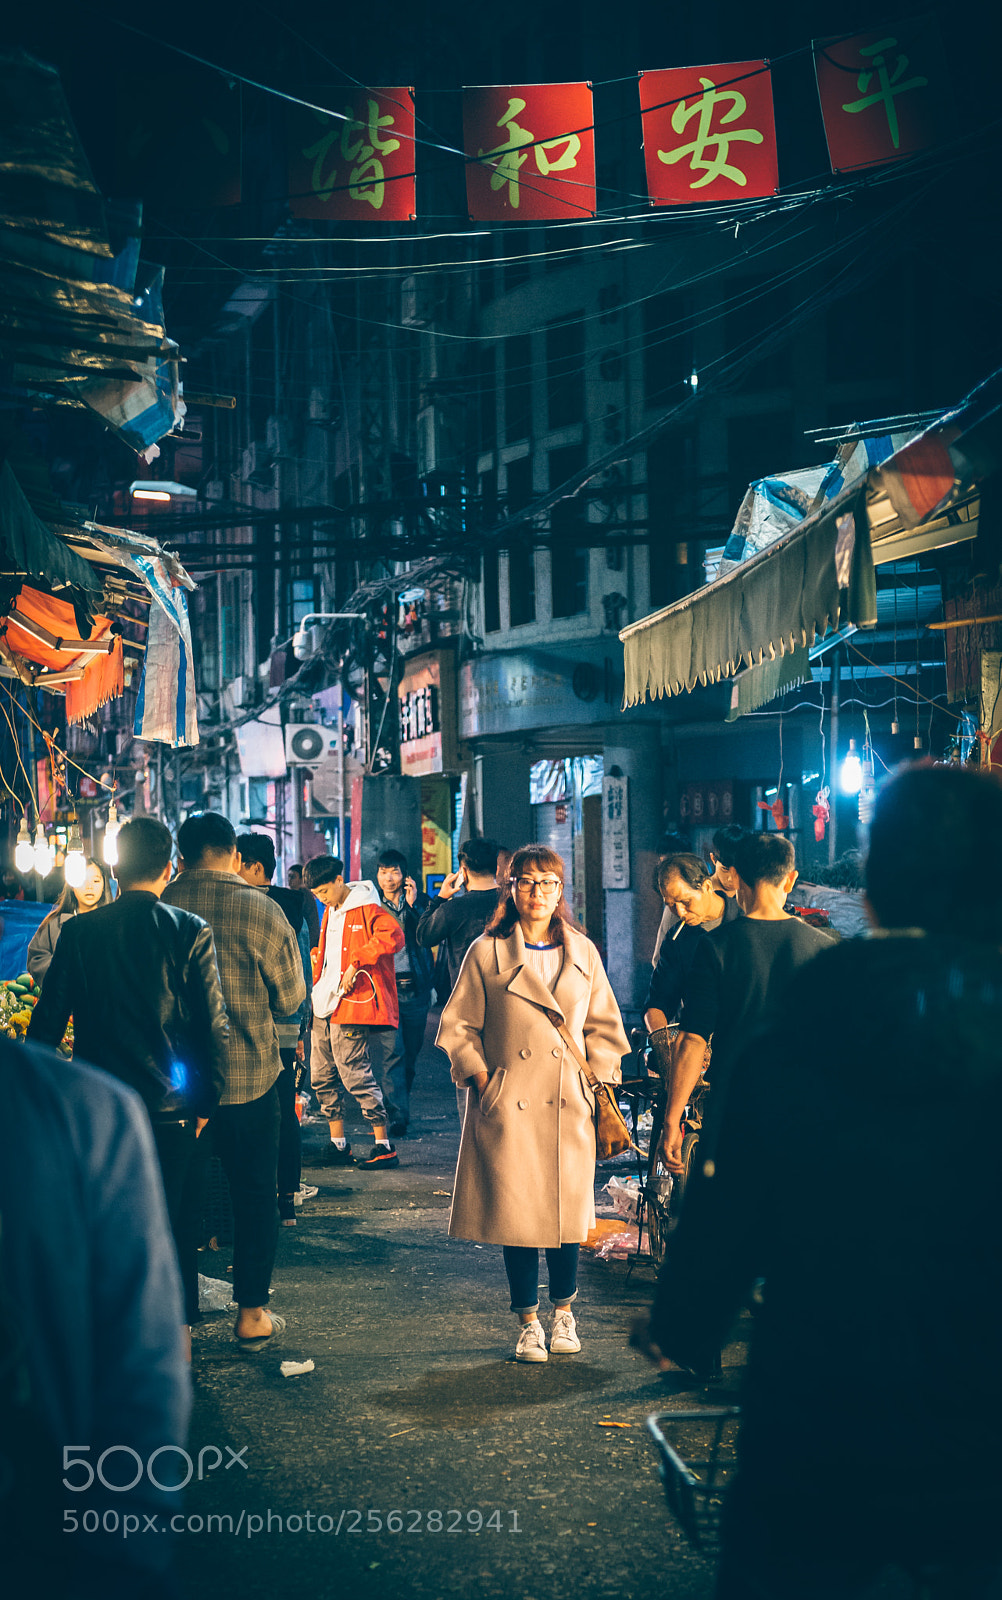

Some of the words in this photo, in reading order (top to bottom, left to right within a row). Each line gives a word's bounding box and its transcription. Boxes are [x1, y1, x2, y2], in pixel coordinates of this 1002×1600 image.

[656, 77, 765, 190] 安
[841, 37, 929, 150] 平
[302, 98, 401, 210] 谐
[477, 97, 581, 209] 和
